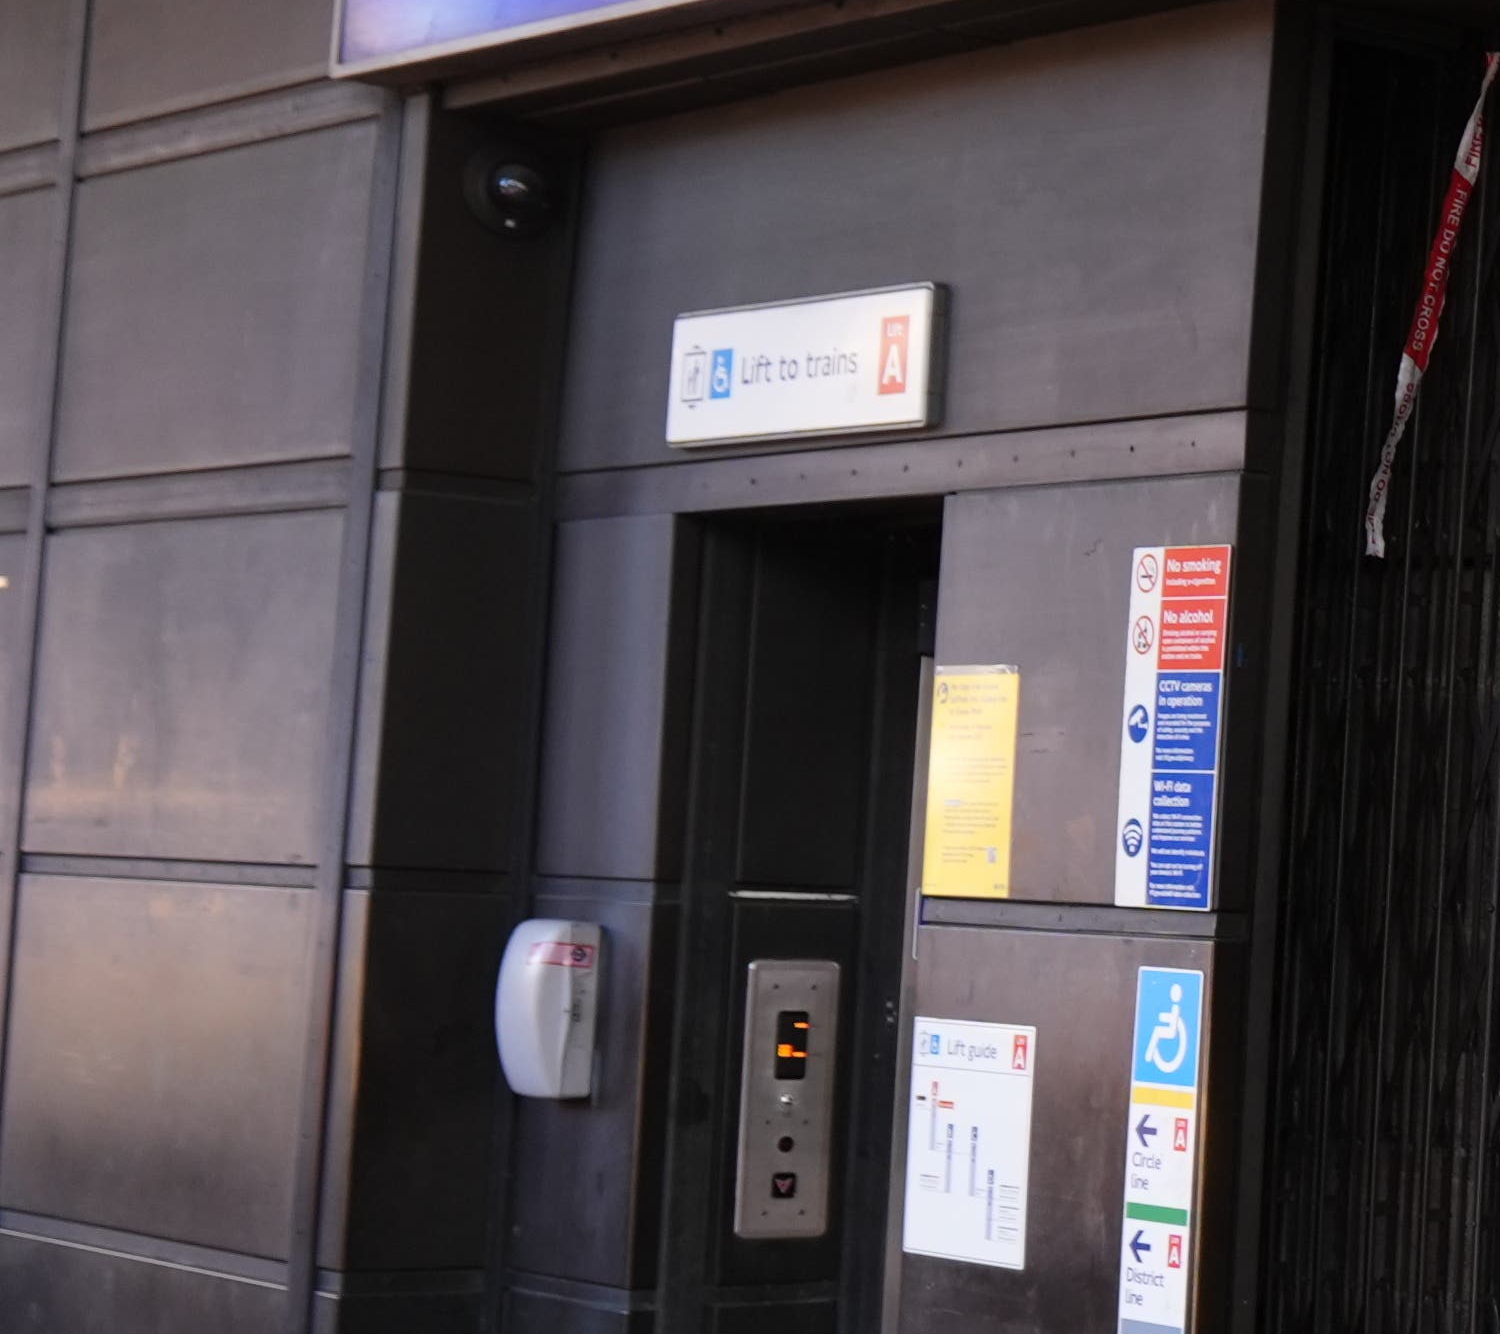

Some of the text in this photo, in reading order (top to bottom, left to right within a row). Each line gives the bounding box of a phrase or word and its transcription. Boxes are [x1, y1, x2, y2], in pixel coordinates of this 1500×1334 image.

[1447, 188, 1467, 227] FIRE
[1440, 229, 1455, 253] DO
[740, 347, 858, 385] Lift to trains
[881, 342, 904, 385] A
[1166, 557, 1221, 574] No smoking
[1163, 609, 1214, 624] No alcohol
[1158, 680, 1180, 693] CCTV
[947, 1039, 998, 1062] Lift guide
[1132, 1151, 1162, 1170] Circle
[1131, 1172, 1149, 1190] line
[1127, 1267, 1164, 1287] District
[1125, 1288, 1143, 1307] line
